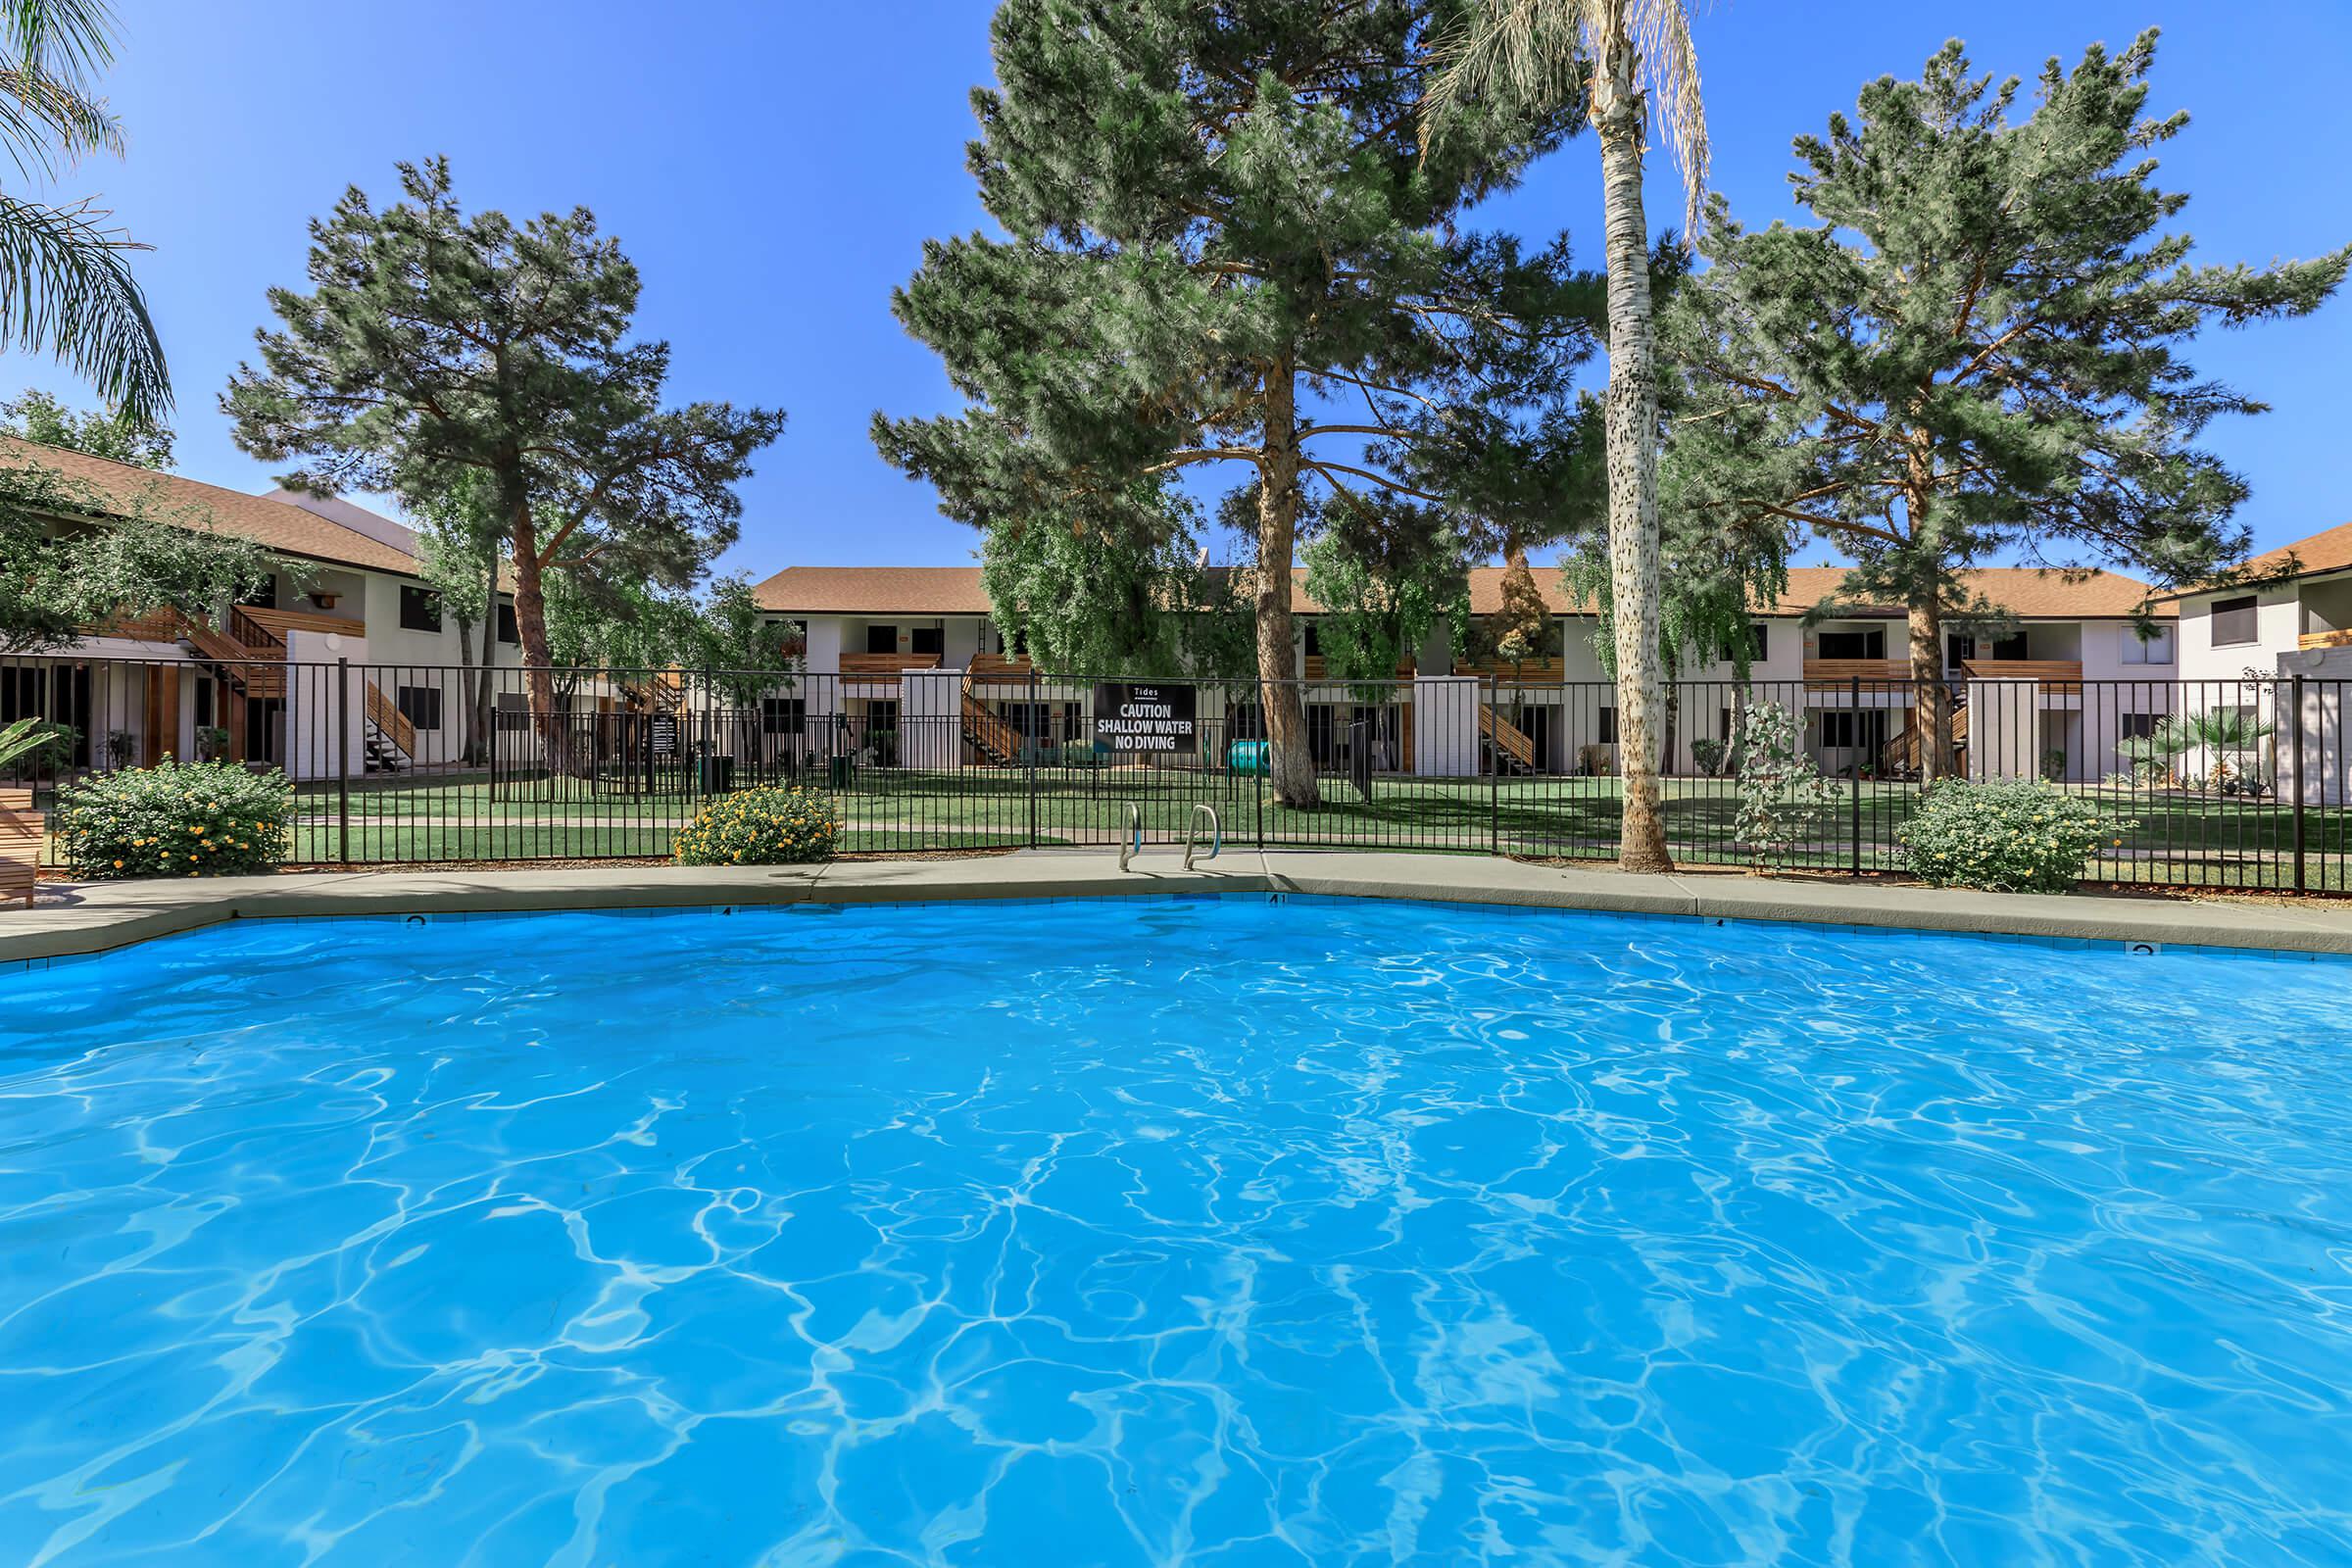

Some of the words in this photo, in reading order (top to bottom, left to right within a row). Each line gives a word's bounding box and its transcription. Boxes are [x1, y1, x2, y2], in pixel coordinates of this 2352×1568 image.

[1134, 687, 1158, 696] Tides
[1120, 704, 1171, 718] CAUTION
[1098, 719, 1152, 733] SHALLOW
[1154, 720, 1193, 734] WATER
[1115, 735, 1133, 749] NO
[1135, 736, 1175, 750] DIVING
